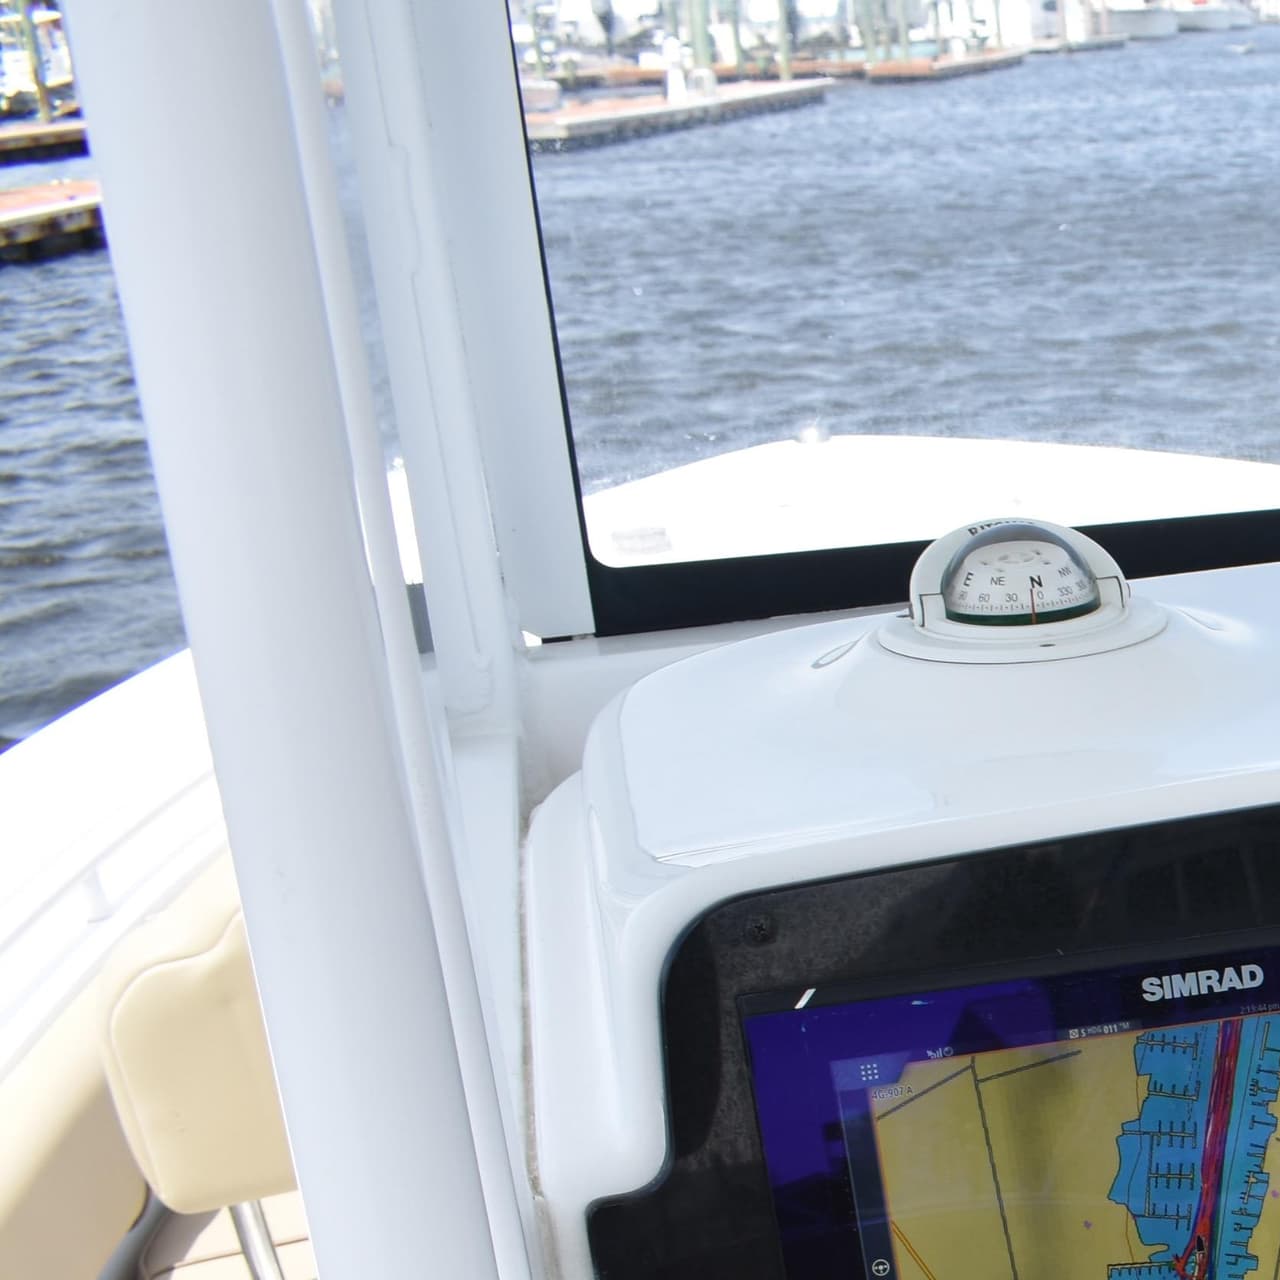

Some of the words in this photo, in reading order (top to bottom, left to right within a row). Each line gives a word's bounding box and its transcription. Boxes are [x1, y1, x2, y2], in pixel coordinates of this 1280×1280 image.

[964, 572, 974, 587] E
[990, 577, 1006, 586] NE
[1029, 575, 1043, 589] N
[978, 593, 991, 603] 60
[1006, 592, 1018, 602] 30
[1141, 964, 1265, 1001] SIMRAD
